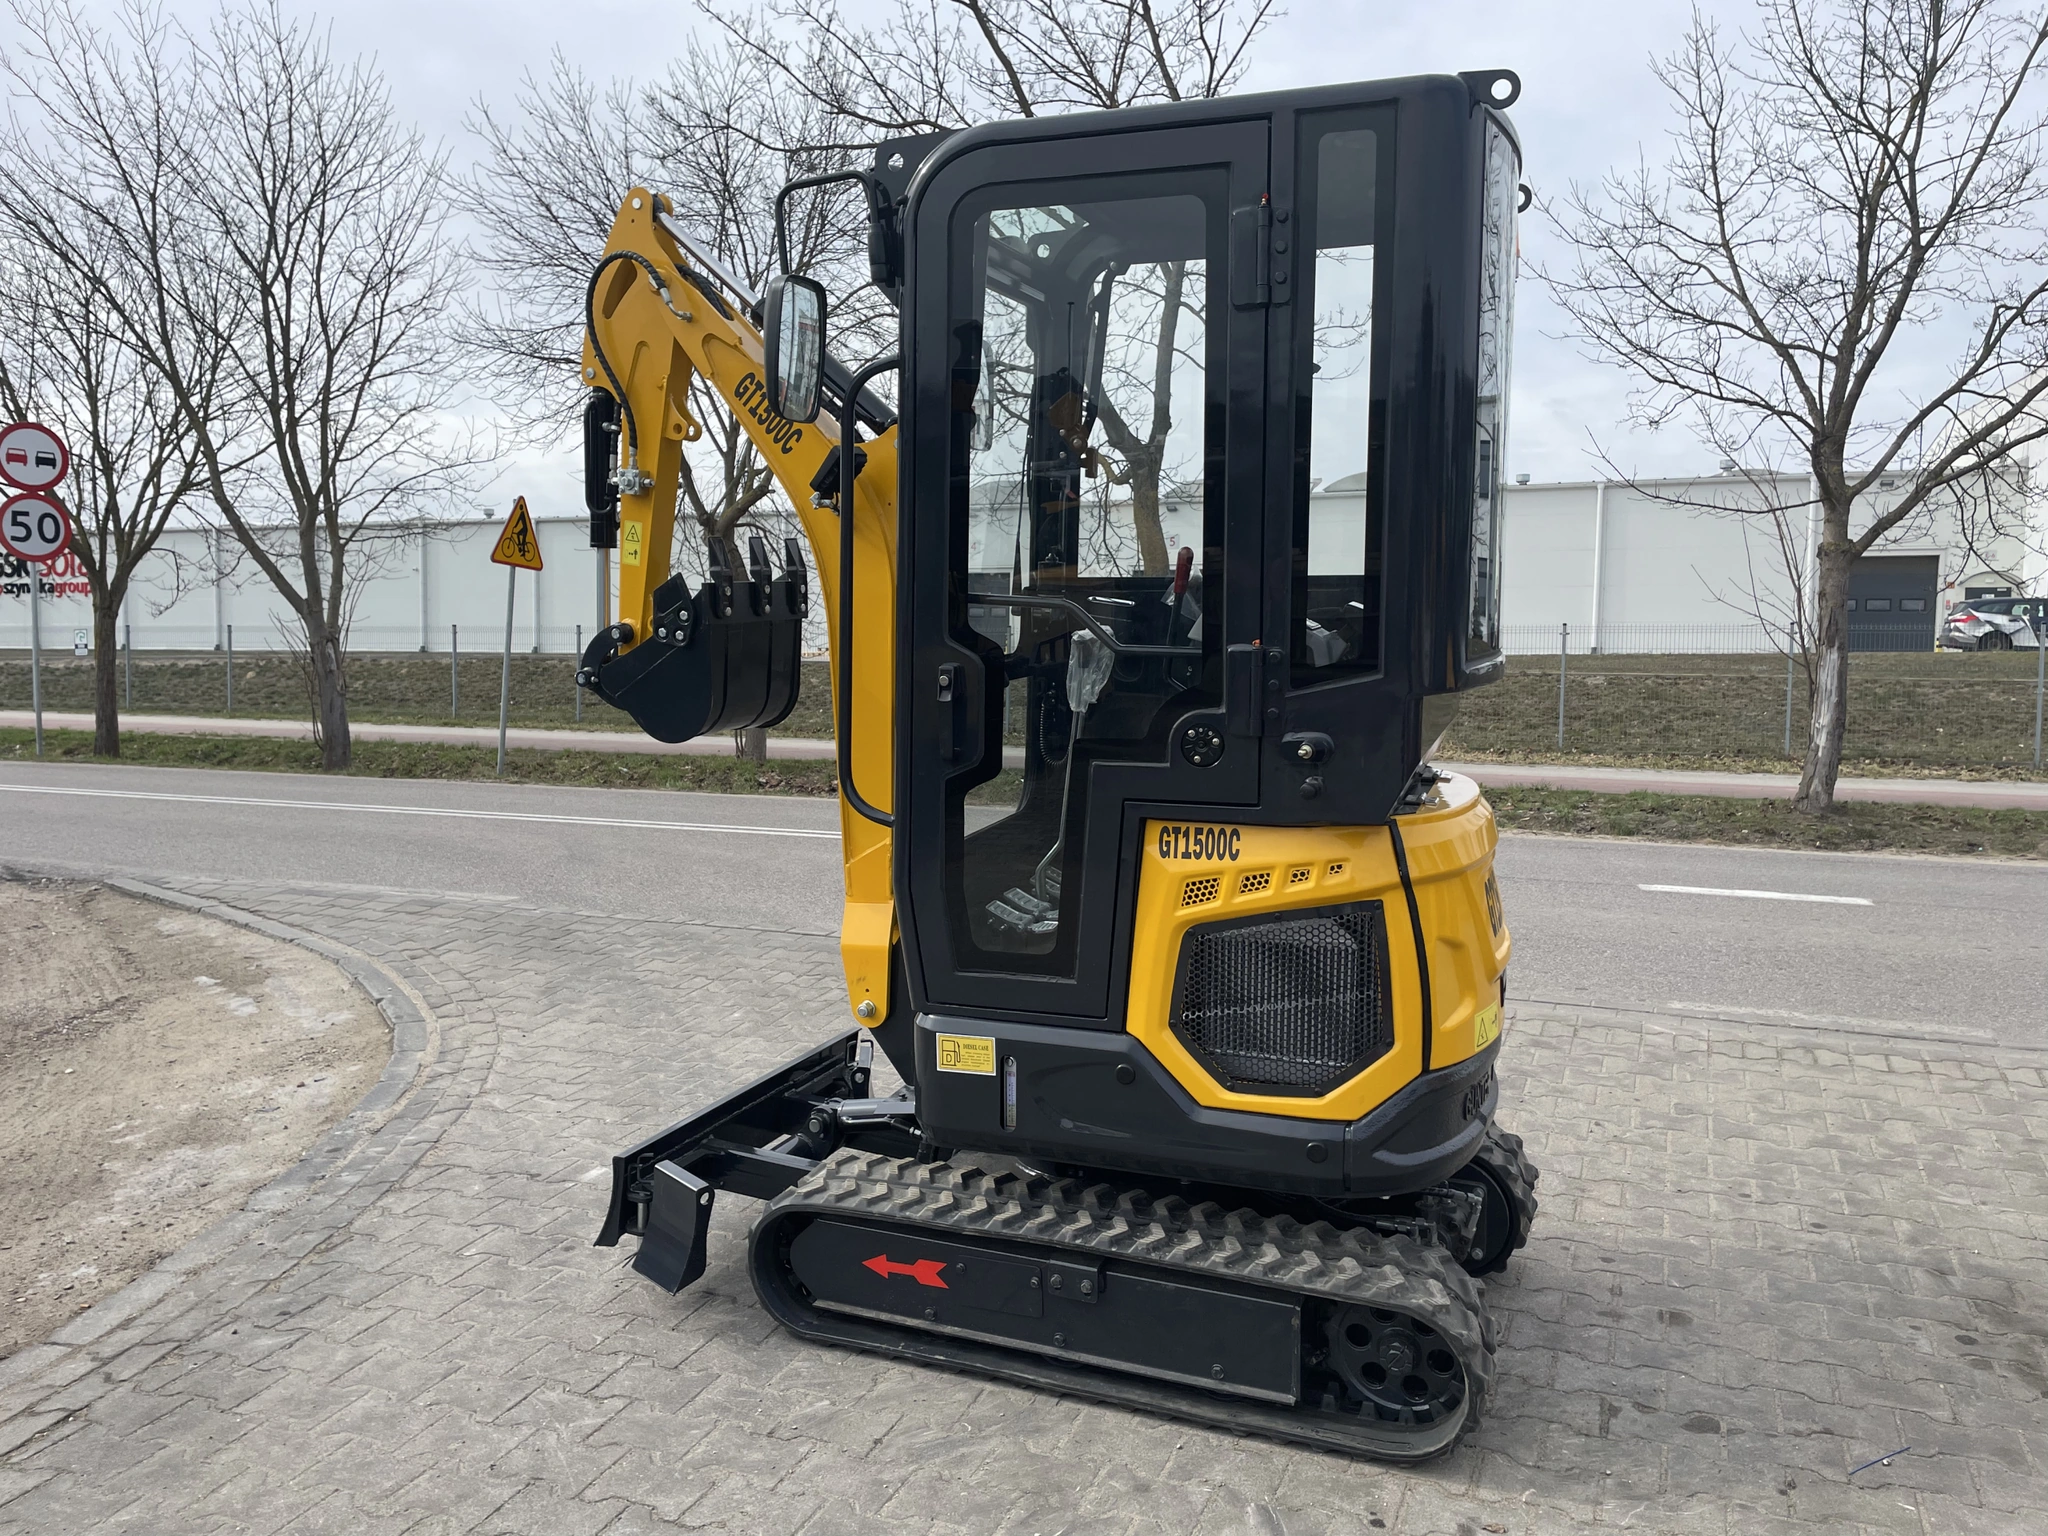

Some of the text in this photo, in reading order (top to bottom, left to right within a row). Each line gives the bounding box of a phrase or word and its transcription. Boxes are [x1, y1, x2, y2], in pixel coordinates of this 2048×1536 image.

[734, 372, 803, 455] GT1500C
[10, 510, 61, 544] 50
[1169, 536, 1176, 547] 5
[1158, 825, 1241, 862] GT1500C
[945, 1053, 952, 1063] D
